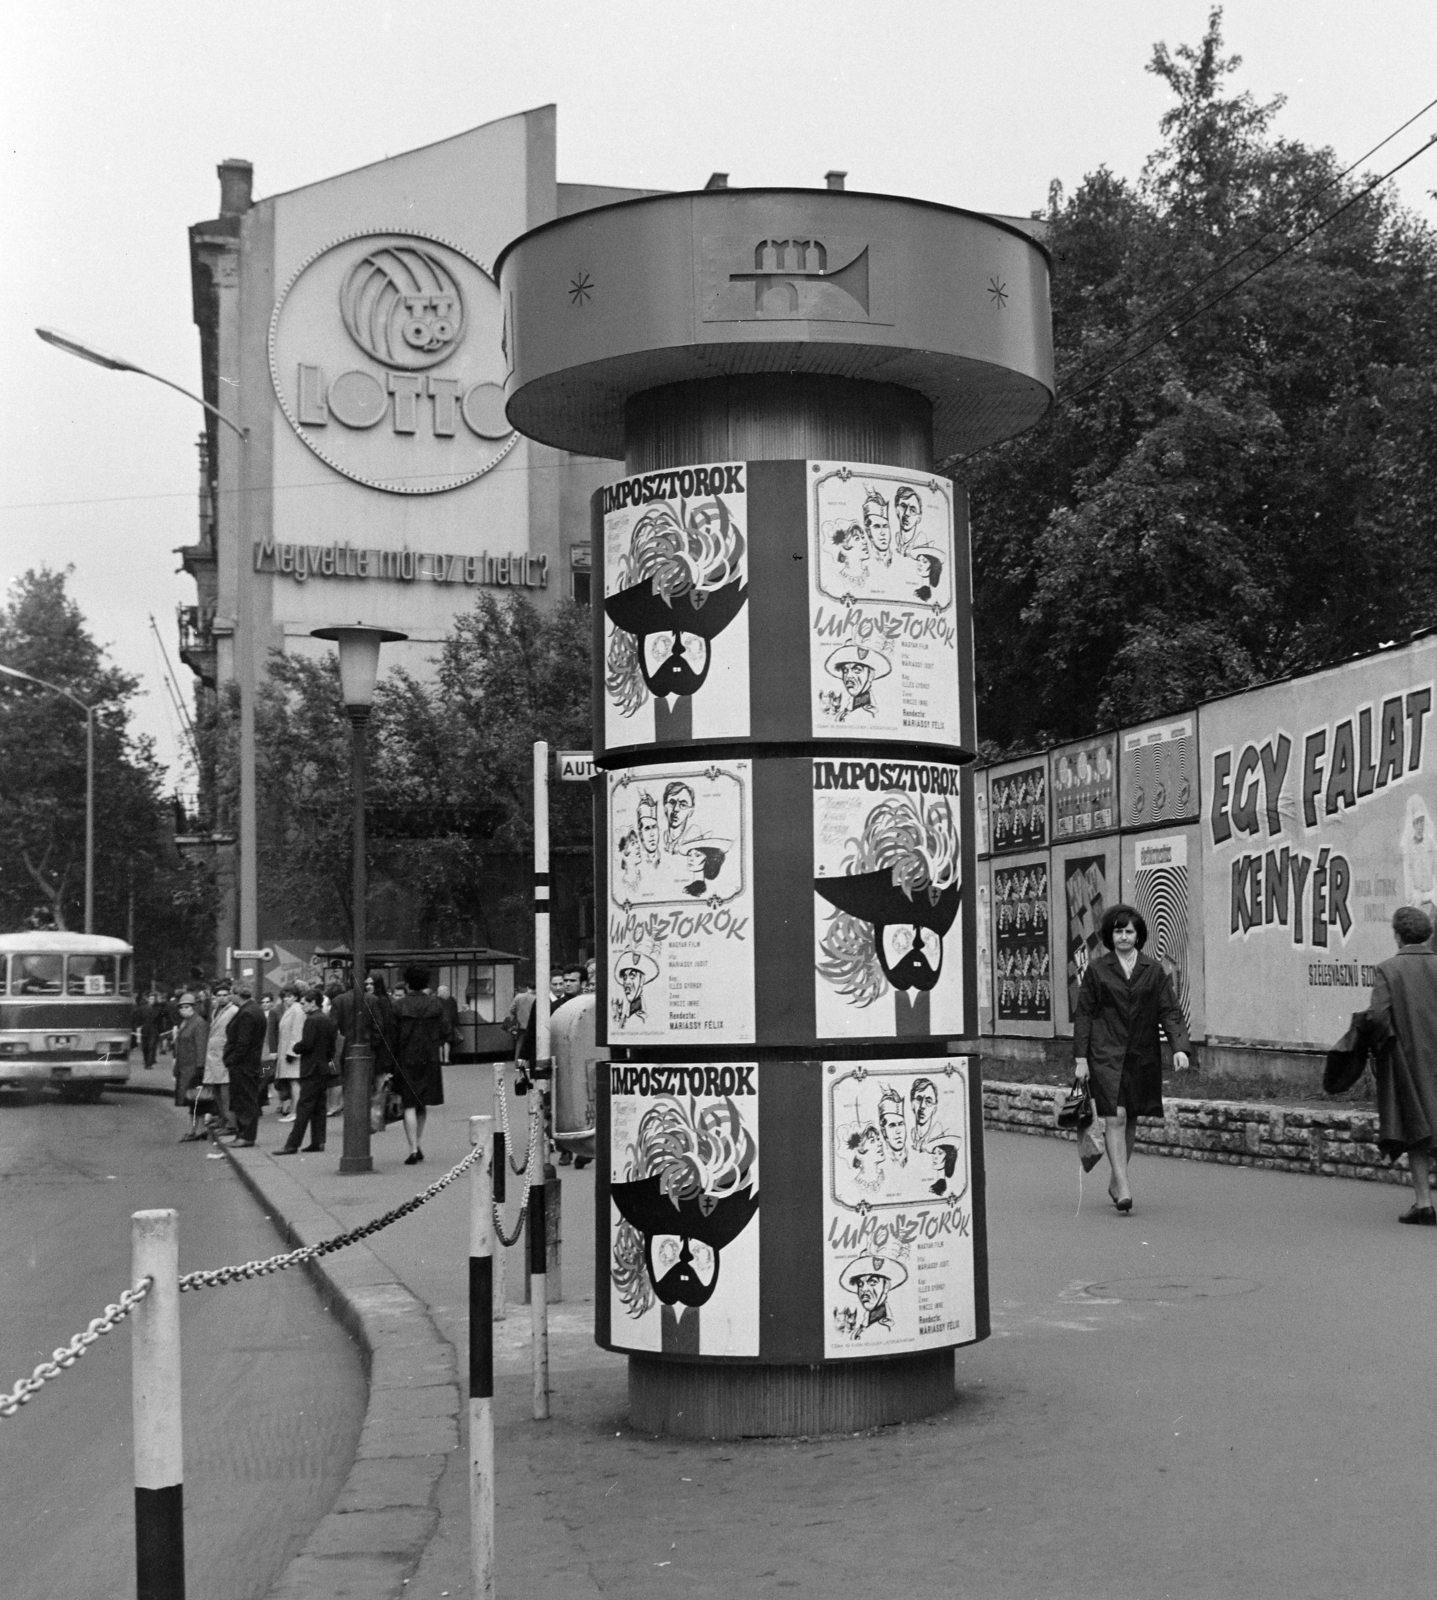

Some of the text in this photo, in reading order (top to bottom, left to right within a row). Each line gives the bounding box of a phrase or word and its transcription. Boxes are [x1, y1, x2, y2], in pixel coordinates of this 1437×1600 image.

[298, 362, 515, 439] LOTTO
[603, 465, 746, 515] IMPOSZTOROK
[813, 606, 956, 650] IMPOSZTOROK
[813, 761, 959, 796] IMPOSZTOROK
[1210, 684, 1433, 847] EGY FALAT
[1229, 844, 1354, 950] KENYÉR
[609, 908, 749, 944] IMPOSZTOROK
[1308, 958, 1359, 987] SZÉLESVÁSZNÚ
[611, 1066, 757, 1097] IMPOSZTOROK
[827, 1206, 970, 1249] IMPOSZTOROK
